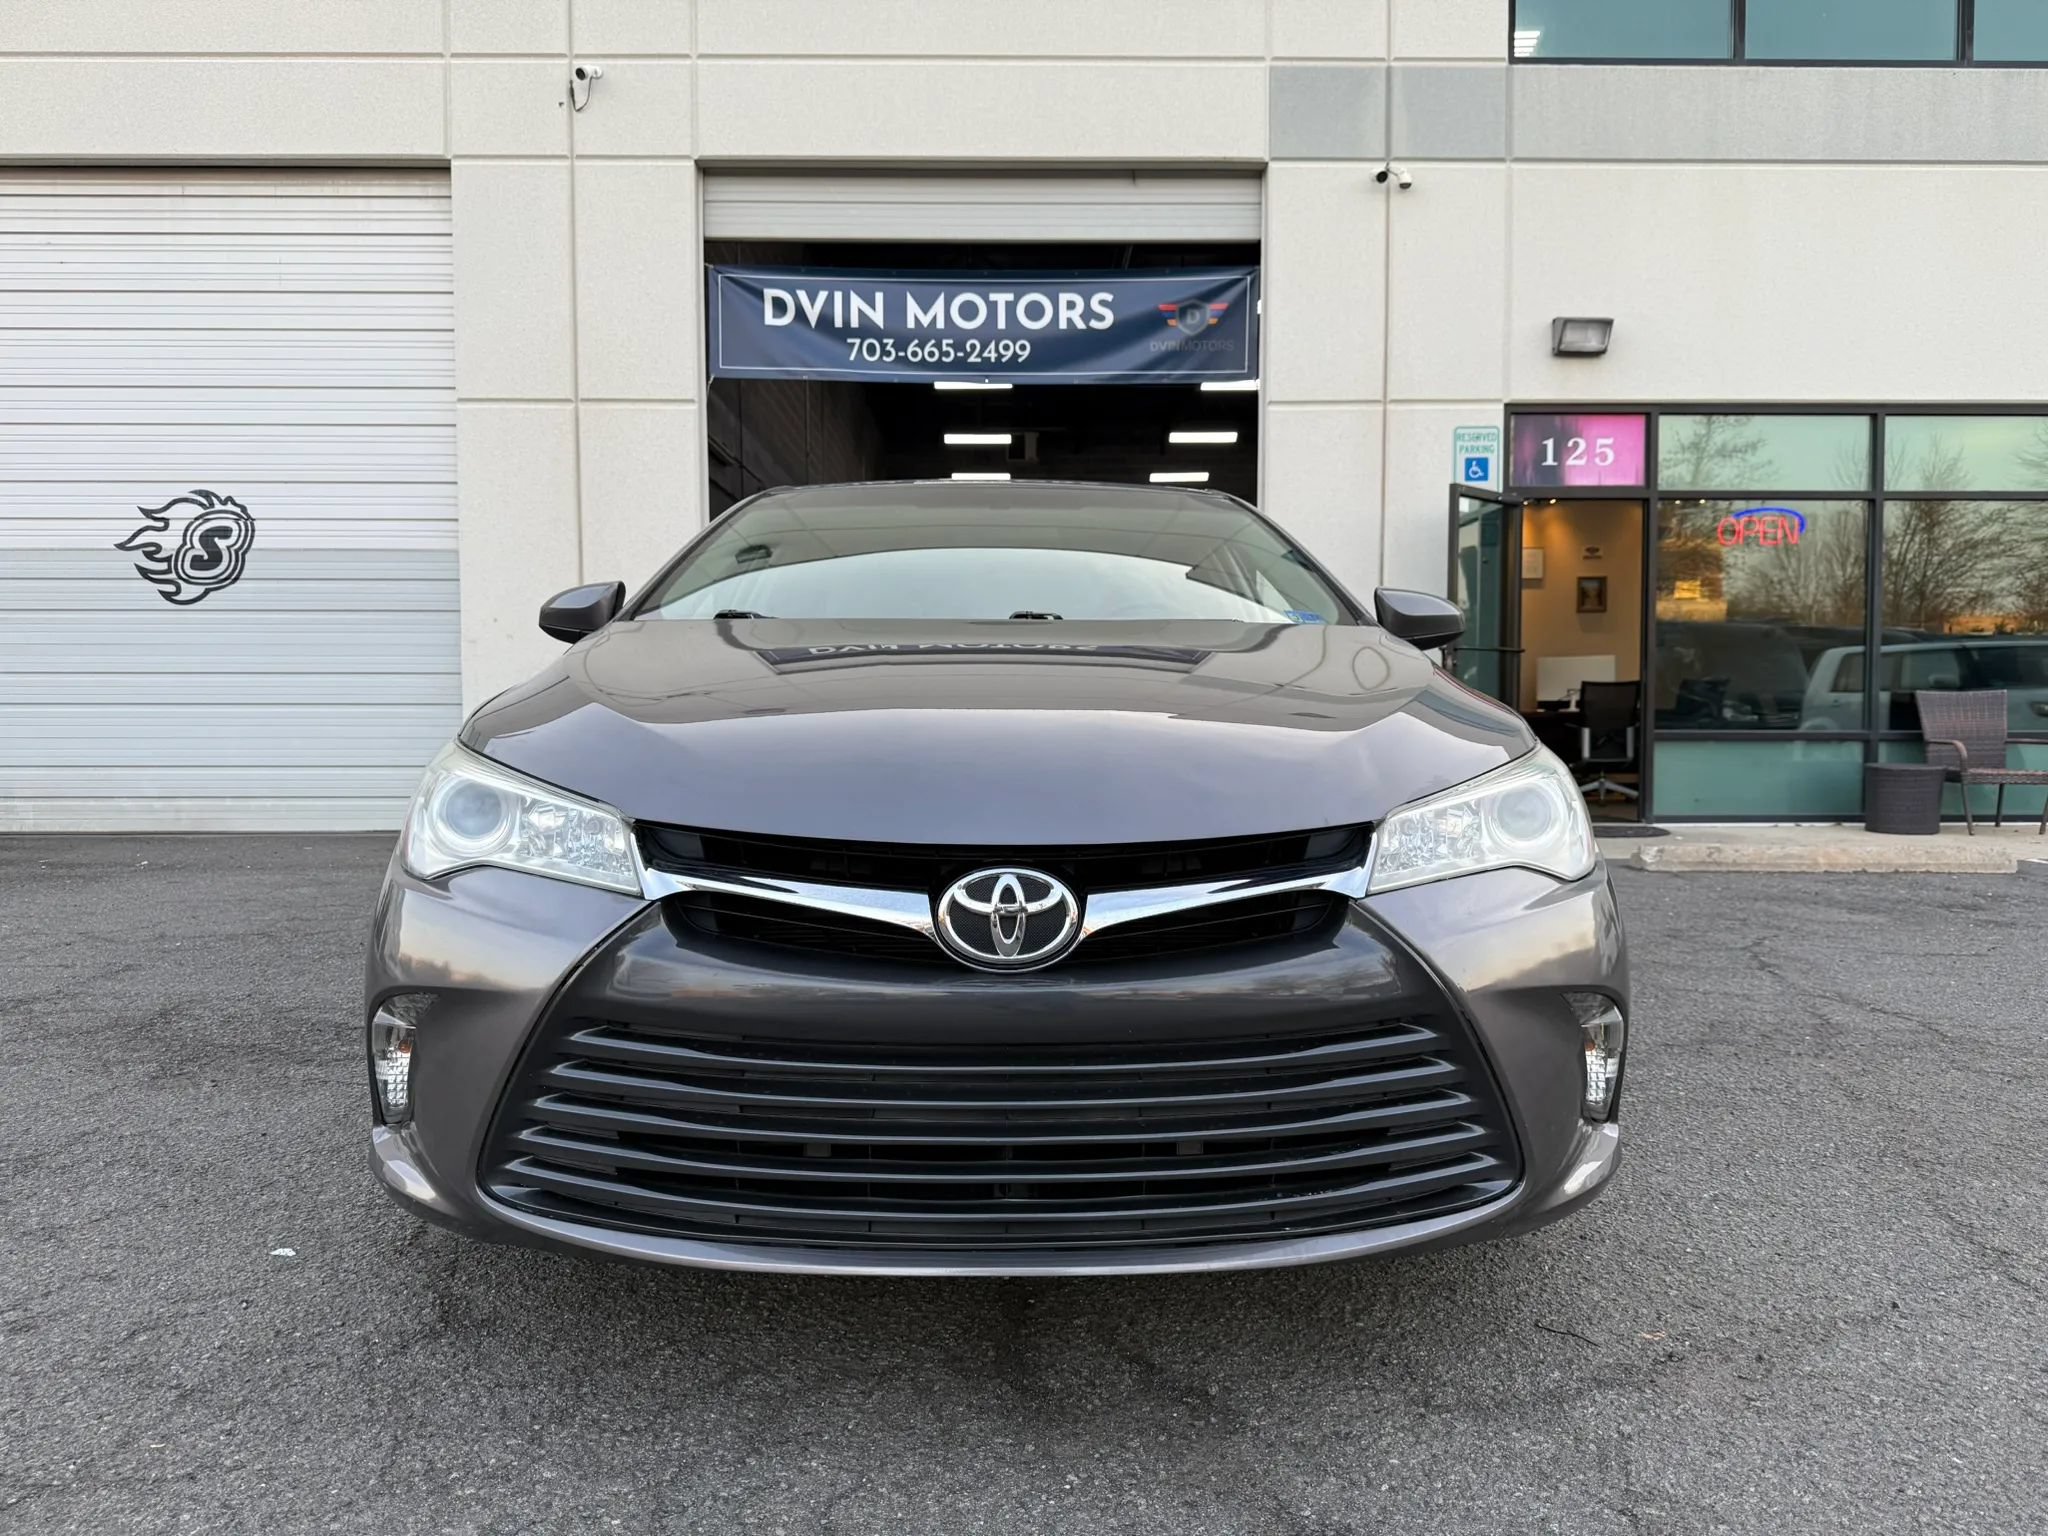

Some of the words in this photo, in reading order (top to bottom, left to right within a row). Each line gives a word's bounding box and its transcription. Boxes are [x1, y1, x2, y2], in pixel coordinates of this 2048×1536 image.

[763, 288, 884, 329] DVIN
[906, 291, 1114, 330] MOTORS
[847, 338, 1031, 363] 703-665-2499
[1456, 432, 1497, 442] RESERVED
[1459, 444, 1495, 454] PARKING
[1541, 437, 1615, 466] 125
[1717, 515, 1799, 547] OPEN
